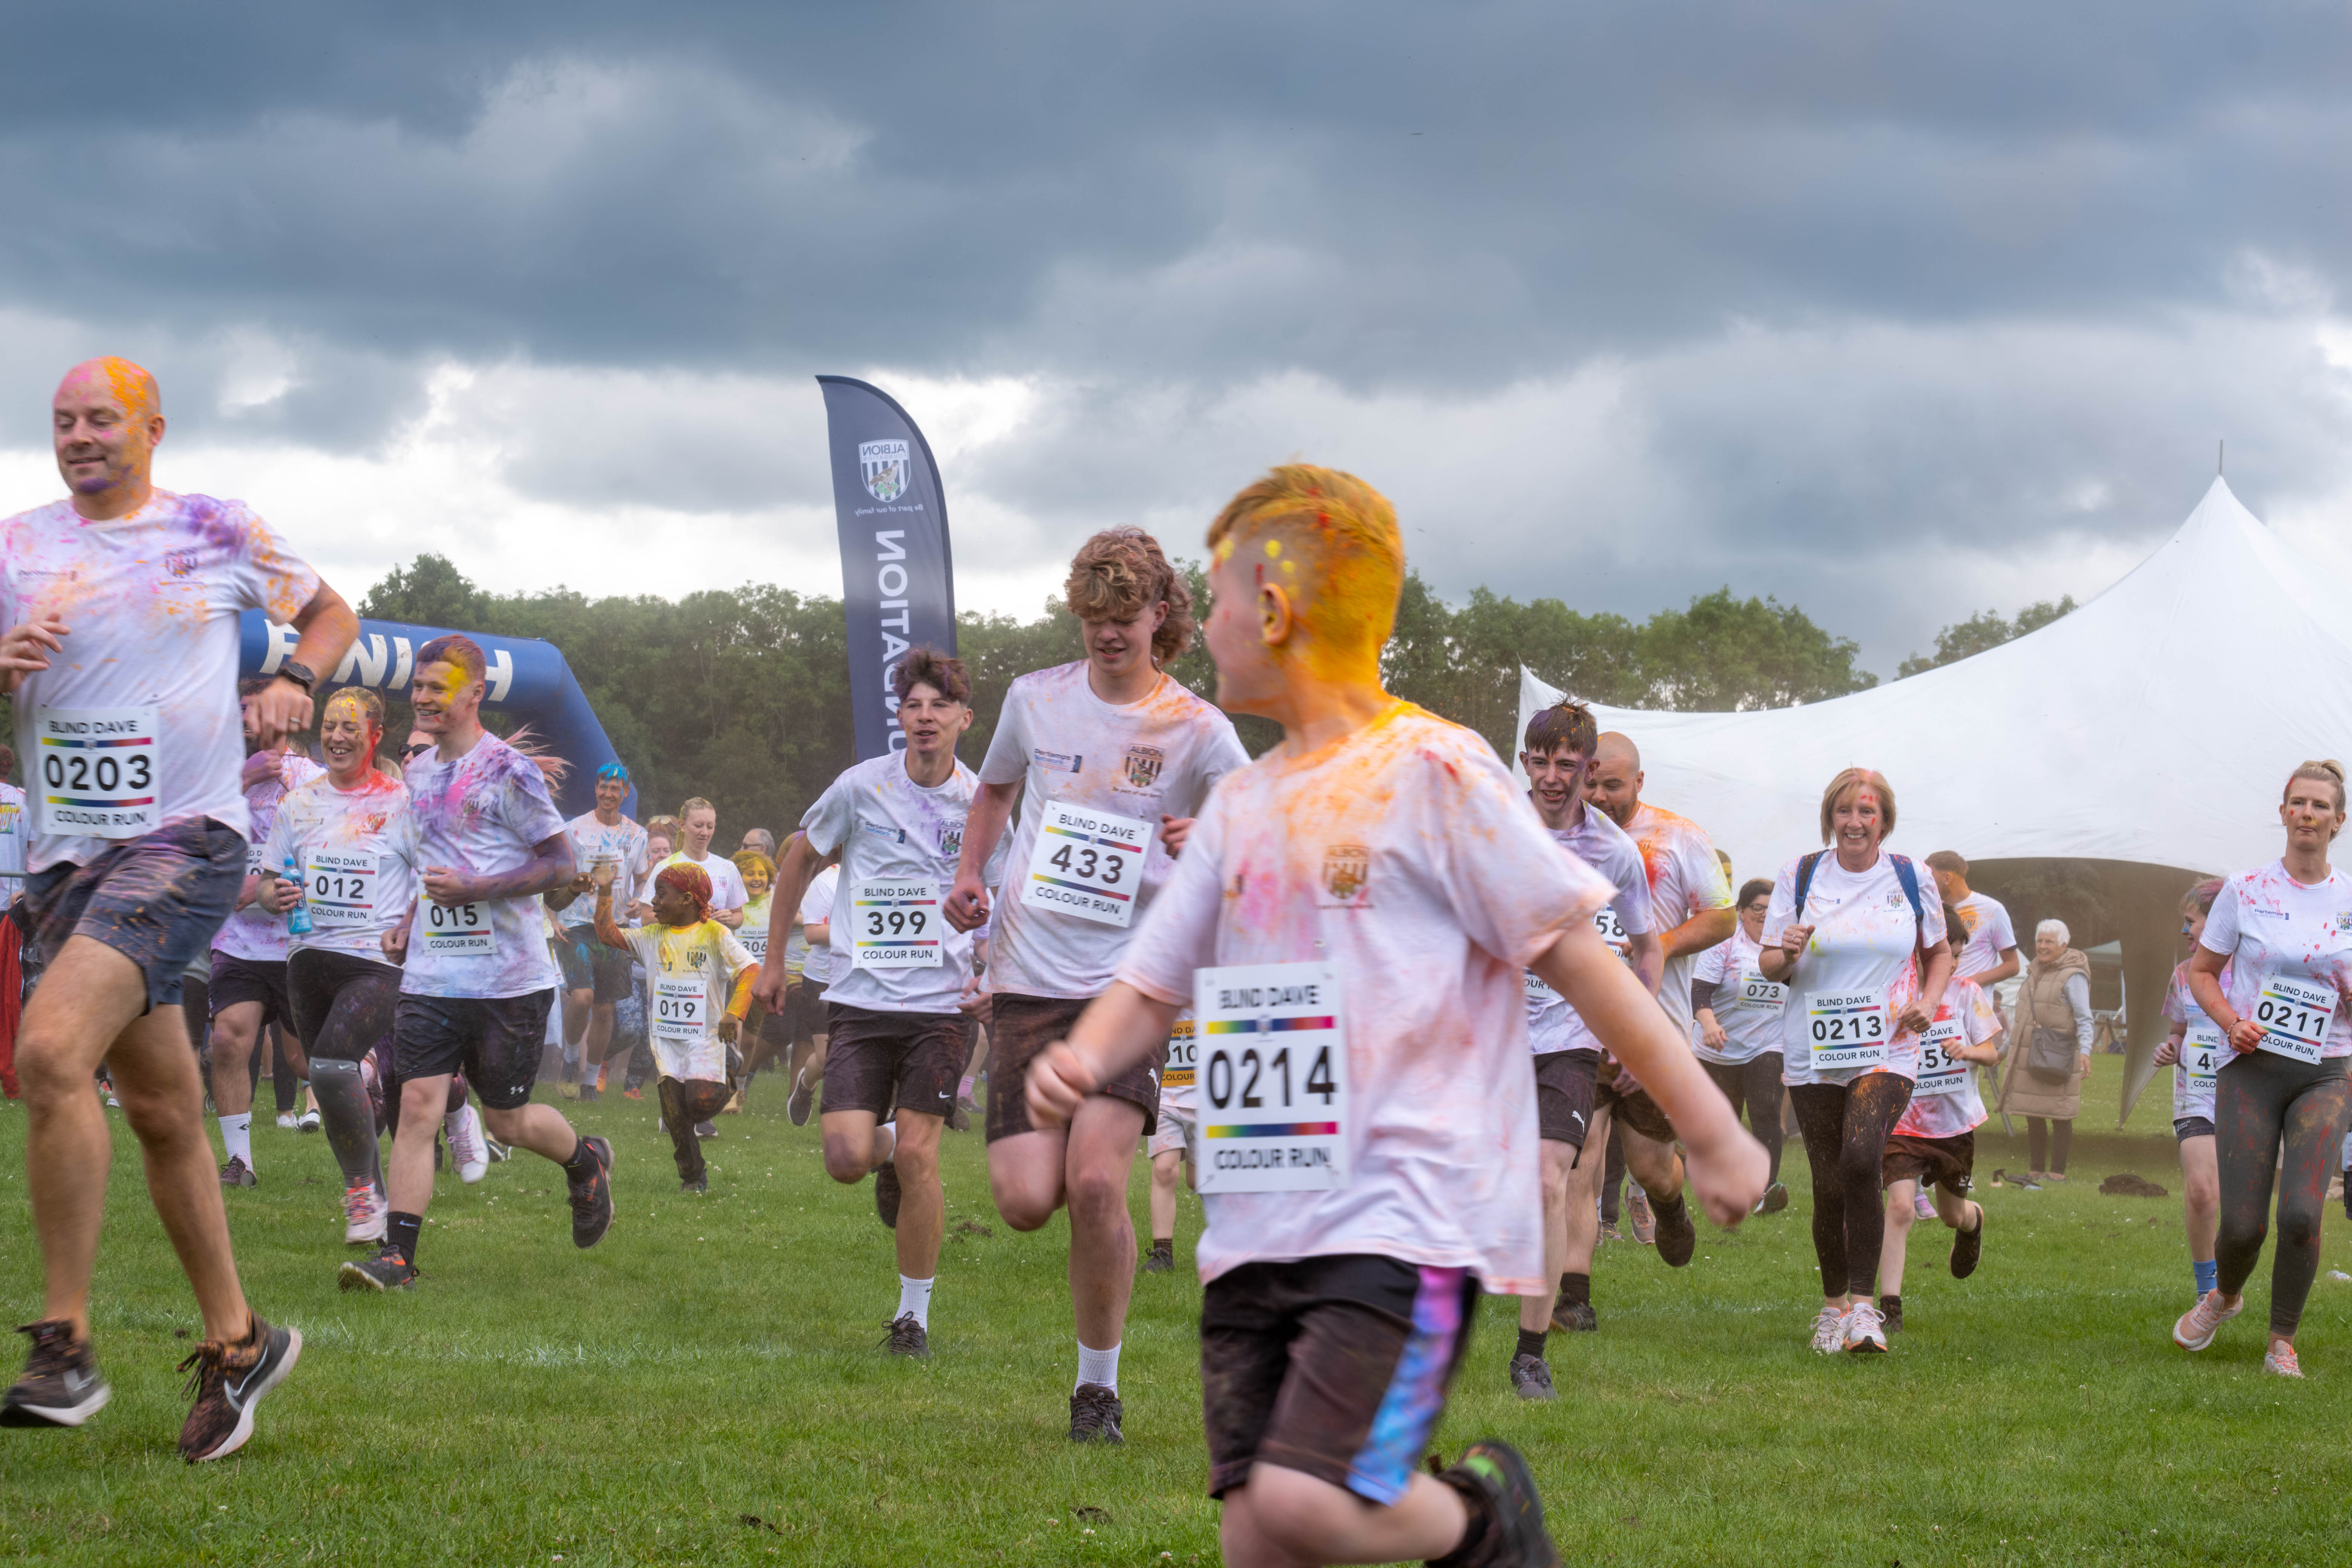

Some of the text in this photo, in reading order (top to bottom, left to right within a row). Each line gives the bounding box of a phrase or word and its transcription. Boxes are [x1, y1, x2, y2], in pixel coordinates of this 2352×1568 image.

[259, 619, 513, 701] FNIH
[49, 720, 139, 733] BLIND DAVE
[1034, 748, 1071, 760] Pertemps
[1131, 746, 1164, 757] ALBION
[44, 754, 152, 792] 0203
[55, 810, 147, 825] COLOUR RUN
[1059, 814, 1136, 840] BLIND DAVE
[316, 855, 368, 867] BLIND DAVE
[1050, 844, 1124, 884] 433
[316, 875, 364, 899] 012
[899, 888, 927, 896] DAVE
[1036, 887, 1121, 914] COLOUR RUN
[311, 906, 368, 919] COLOUR RUN
[431, 905, 478, 927] 015
[2255, 908, 2284, 916] Pertemps
[867, 911, 926, 935] 399
[430, 940, 466, 948] COLOUR
[863, 950, 933, 959] COLOUR RUN
[1219, 985, 1321, 1009] BLIND DAVE
[1747, 985, 1779, 998] 073
[2273, 983, 2326, 1003] BLIND DAVE
[1817, 995, 1871, 1006] BLIND DAVE
[660, 1000, 695, 1018] 019
[2258, 1001, 2325, 1037] 0211
[657, 1025, 681, 1034] COLOUR
[1813, 1016, 1881, 1041] 0213
[1931, 1027, 1954, 1037] DAVE
[2261, 1035, 2314, 1056] OLOUR RUN
[1819, 1049, 1880, 1061] COLOUR RUN
[1207, 1046, 1339, 1110] 0214
[1914, 1076, 1963, 1089] OLOUR RUN
[1214, 1147, 1332, 1170] COLOUR RUN
